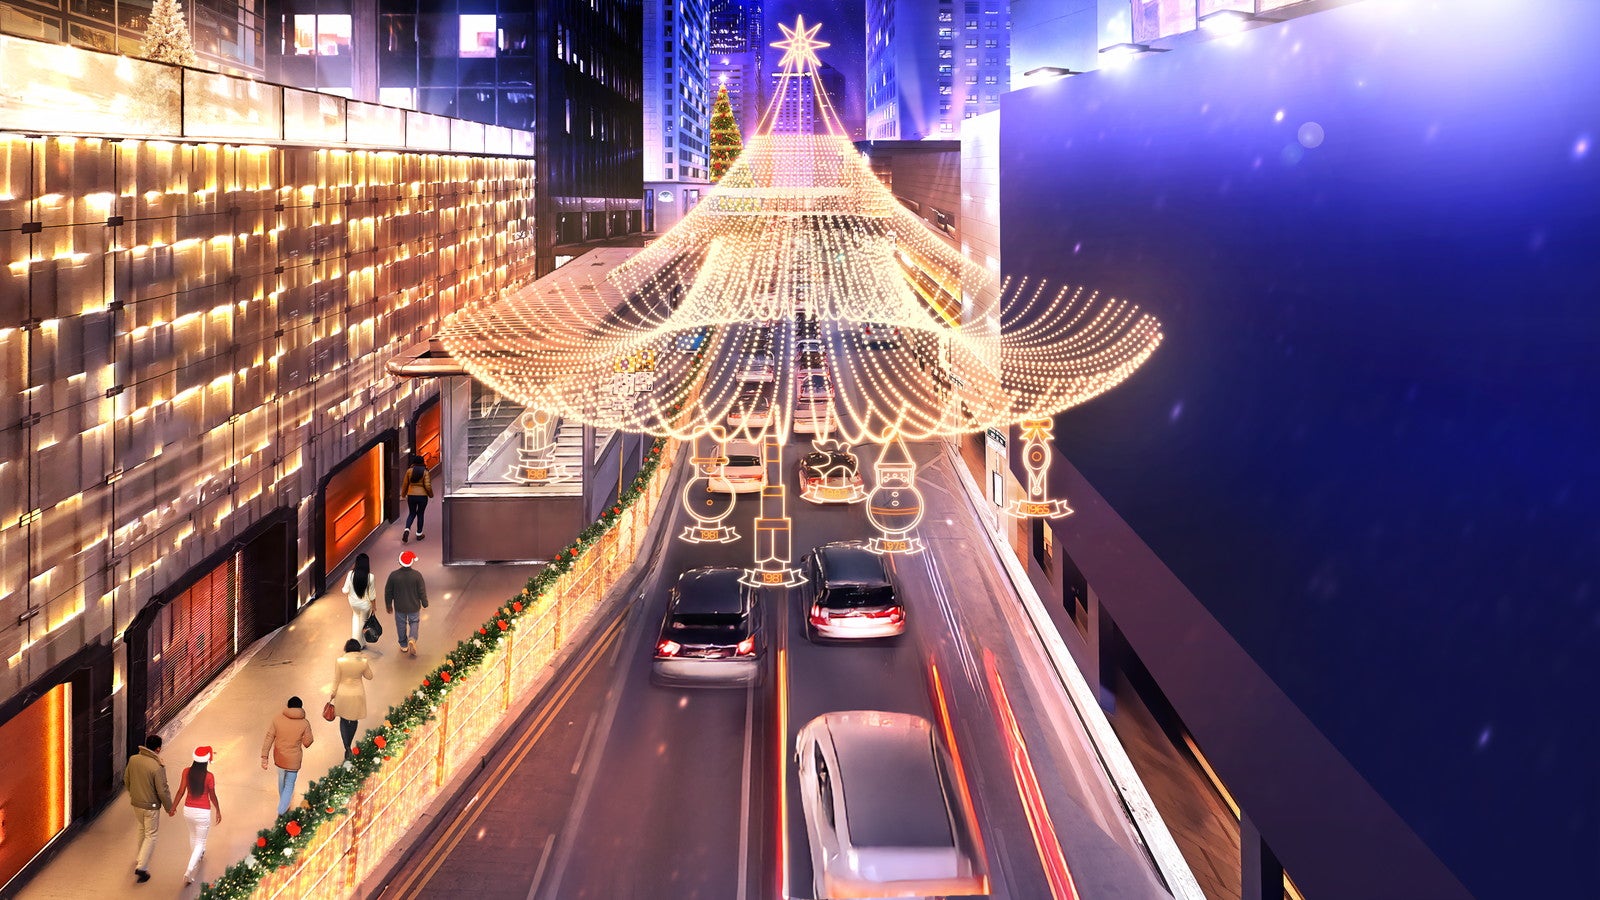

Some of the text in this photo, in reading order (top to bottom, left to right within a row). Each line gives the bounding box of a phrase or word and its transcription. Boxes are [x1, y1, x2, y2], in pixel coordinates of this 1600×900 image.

[526, 469, 547, 479] 1981
[1027, 504, 1050, 514] 1965
[700, 530, 719, 540] 1981
[882, 541, 907, 551] 1978
[761, 573, 783, 583] 1981
